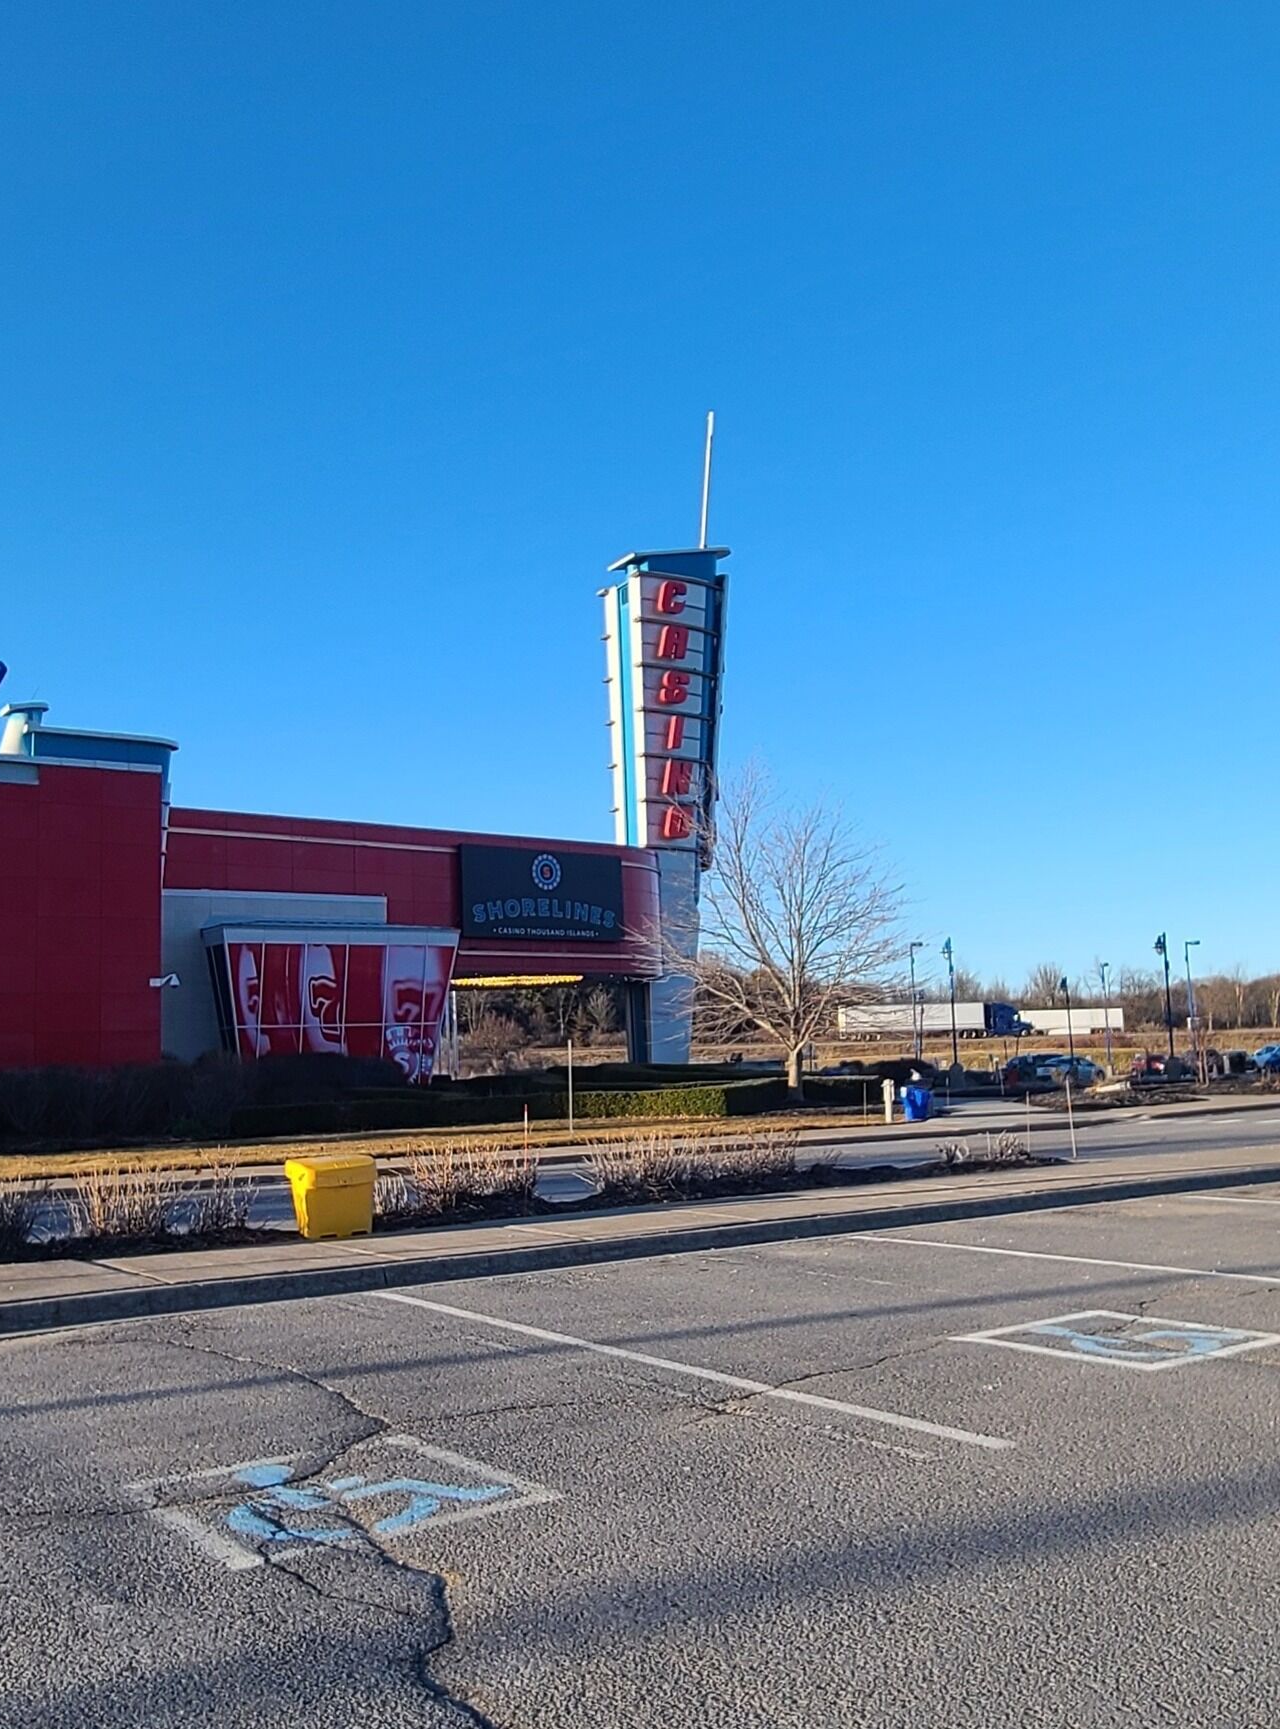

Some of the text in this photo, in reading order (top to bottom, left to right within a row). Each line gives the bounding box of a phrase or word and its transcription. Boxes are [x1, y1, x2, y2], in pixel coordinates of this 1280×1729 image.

[656, 579, 694, 840] CASINO
[542, 866, 551, 878] S
[472, 898, 616, 929] SHORELINES
[497, 927, 595, 937] CASINO THOUSAND ISLANDS
